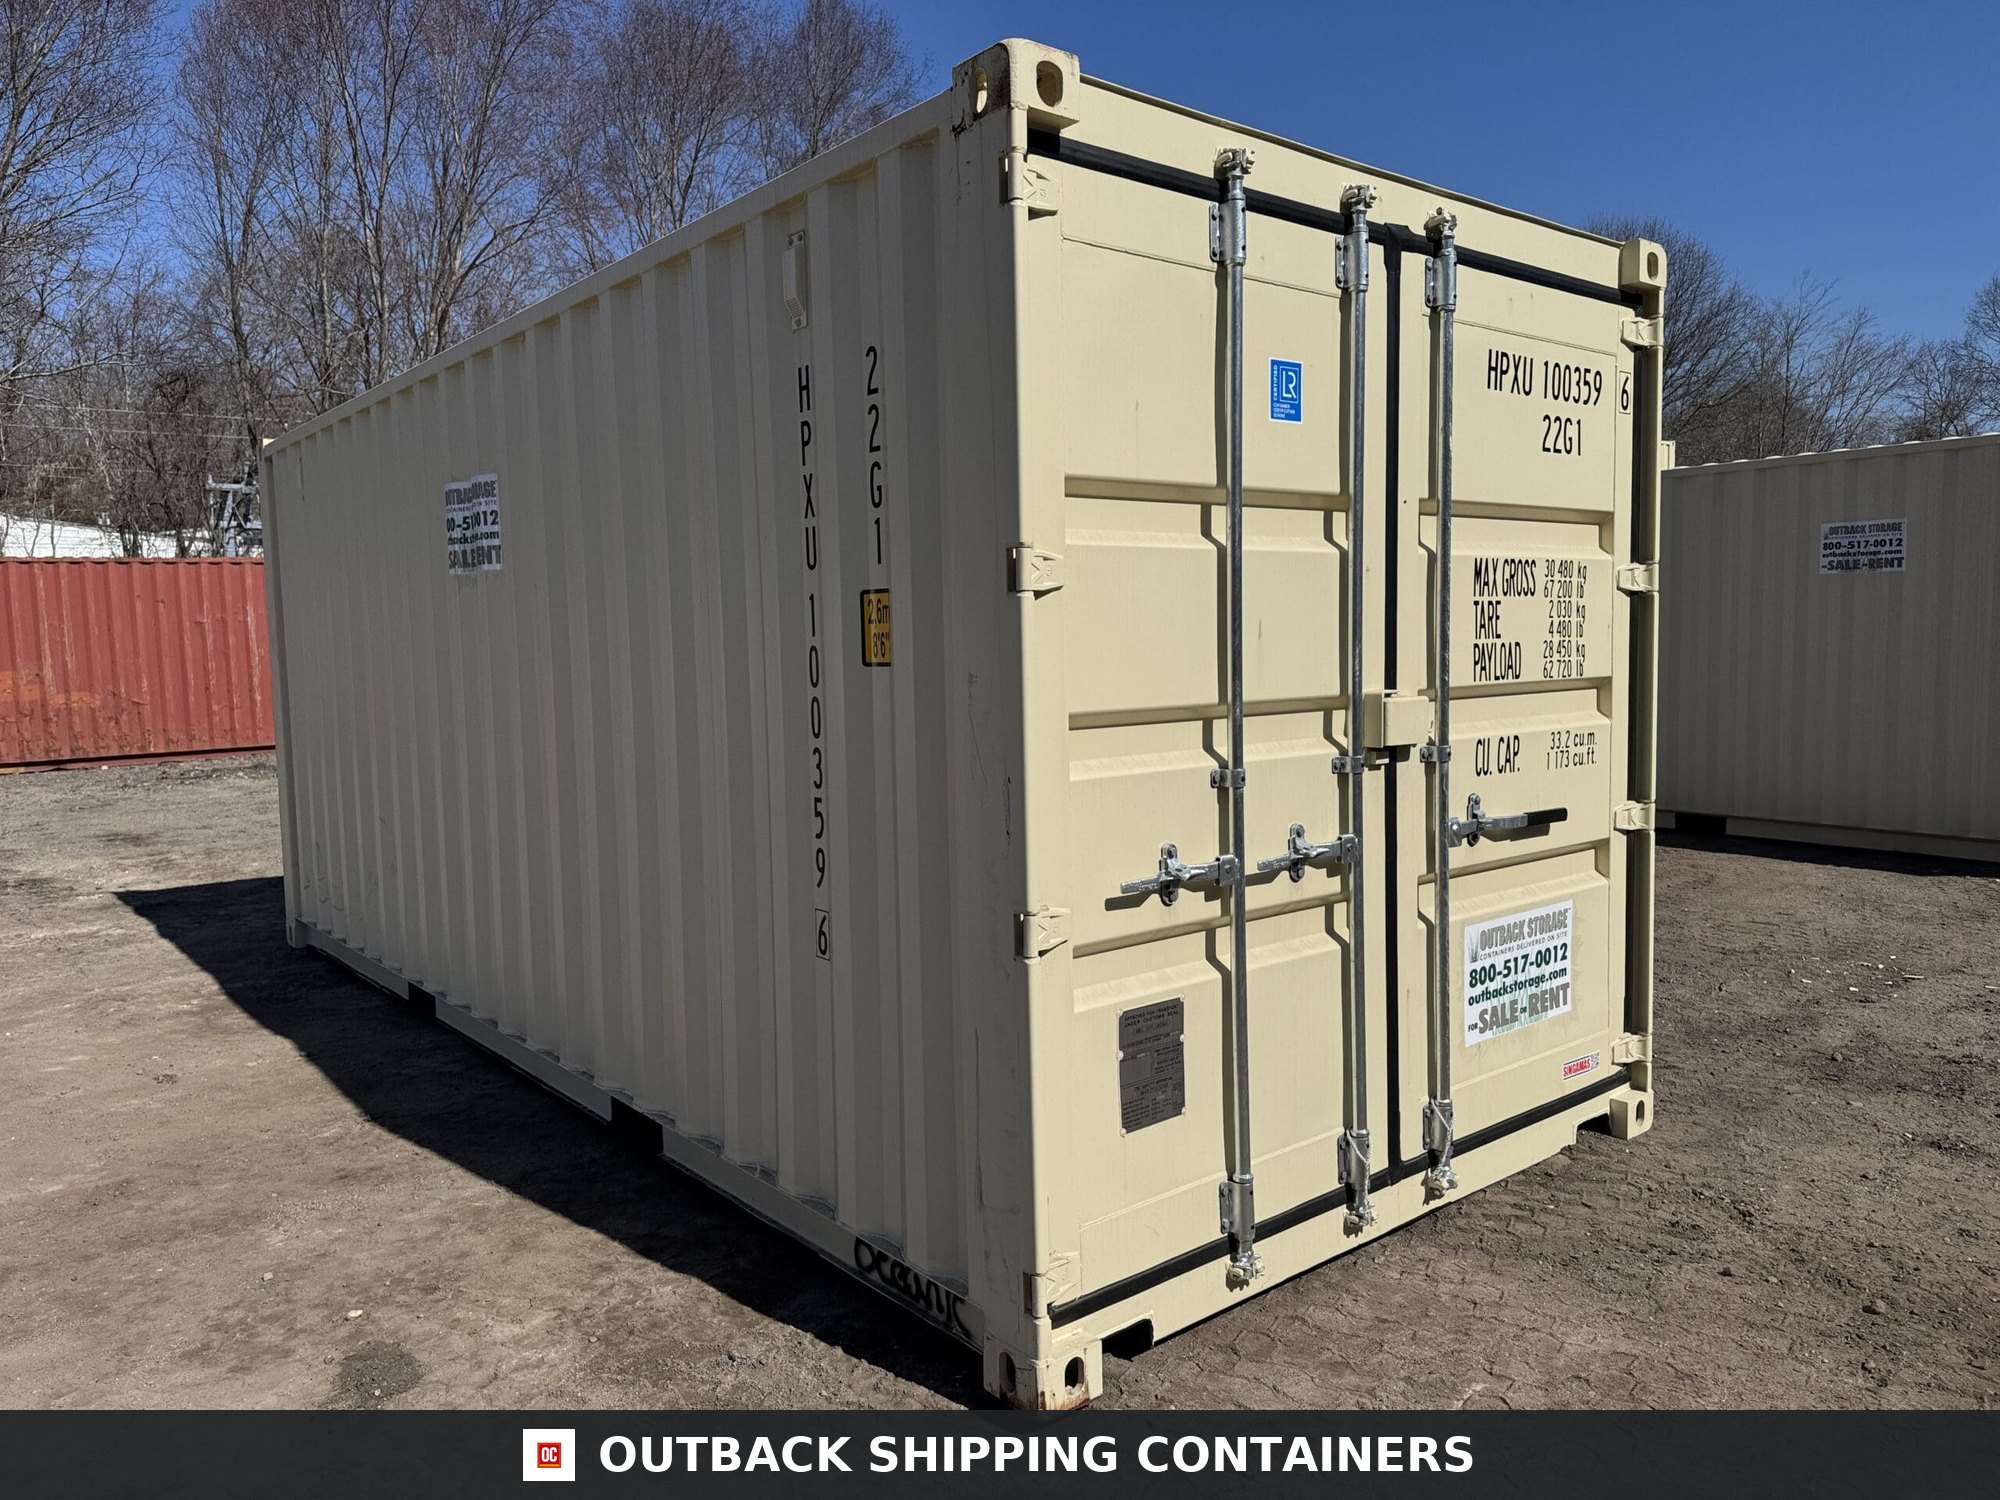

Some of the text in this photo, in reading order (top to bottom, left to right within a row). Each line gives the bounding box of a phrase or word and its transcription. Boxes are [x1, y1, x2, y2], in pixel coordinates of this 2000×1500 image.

[1487, 349, 1630, 411] HPXU 100359 6
[1542, 414, 1581, 456] 22G1
[865, 345, 882, 565] 22G1
[1829, 522, 1903, 535] OUTBACK STORAGE
[1822, 538, 1903, 551] 800-517-0012
[1822, 549, 1902, 559] outbackstorage.com
[1473, 557, 1536, 597] MAX GROSS
[1544, 559, 1587, 584] 30 480 kg
[1827, 560, 1861, 571] SALE
[1868, 557, 1904, 570] RENT
[1544, 579, 1584, 599] 67 200 lb
[1473, 600, 1501, 640] TARE
[1549, 600, 1586, 624] 2 030 kg
[1549, 620, 1584, 639] 4 480 lb
[798, 364, 829, 957] HPXU 100359 6
[1473, 642, 1521, 682] PAYLOAD
[1543, 640, 1585, 662] 28 450 kg
[1543, 659, 1584, 679] 62 720 lb
[1550, 730, 1571, 750] 33.2
[1475, 735, 1520, 777] CU. CAP.
[1555, 750, 1570, 769] 173
[1479, 909, 1568, 951] OUTBACK STORAGE
[1479, 931, 1568, 961] CONTAINERS DELIVERED ON SITE
[1469, 942, 1568, 989] 800-517-0012
[1468, 967, 1567, 1007] outbackstorage.com
[1468, 982, 1570, 1034] FOR SALE OR RENT
[1563, 1058, 1590, 1077] SINGAMAS
